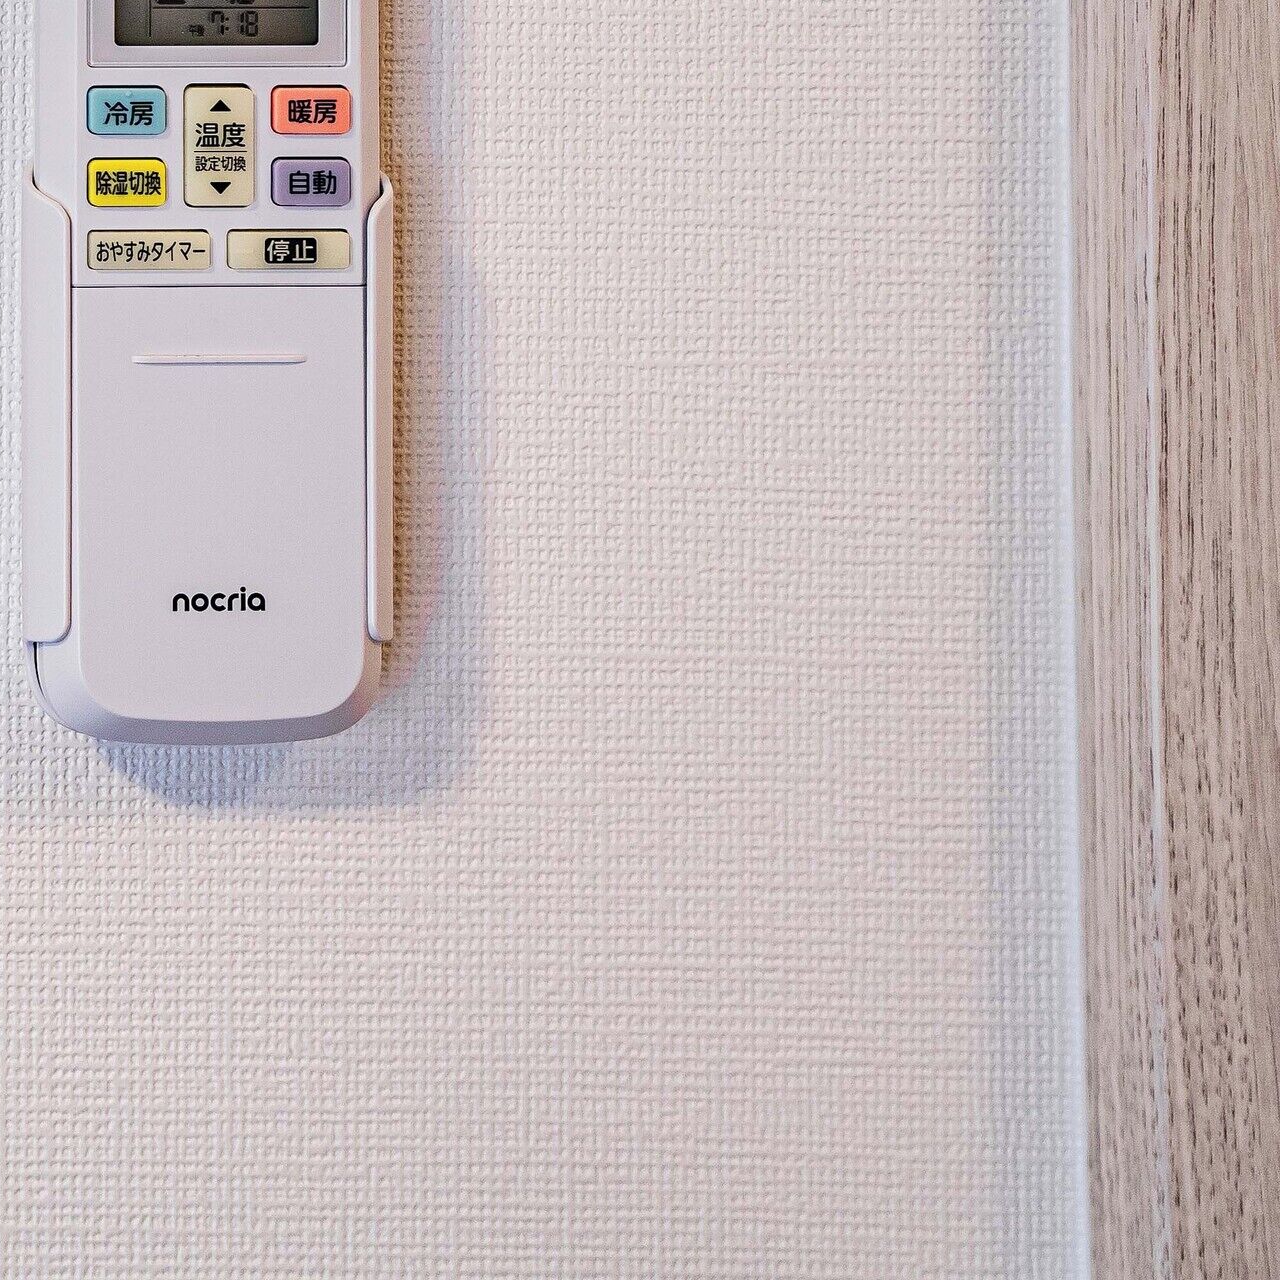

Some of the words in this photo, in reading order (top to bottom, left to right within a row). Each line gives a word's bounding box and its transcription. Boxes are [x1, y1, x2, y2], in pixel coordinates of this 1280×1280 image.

[210, 10, 259, 37] 7:18
[103, 101, 154, 126] 冷房
[288, 99, 338, 124] 暖房
[195, 122, 246, 147] 温度
[195, 156, 246, 172] 設定切換
[95, 171, 161, 195] 除湿切換
[289, 170, 337, 194] 自動
[97, 241, 205, 262] おやすみタイマー
[267, 239, 315, 262] 停止
[173, 587, 265, 611] nocria
